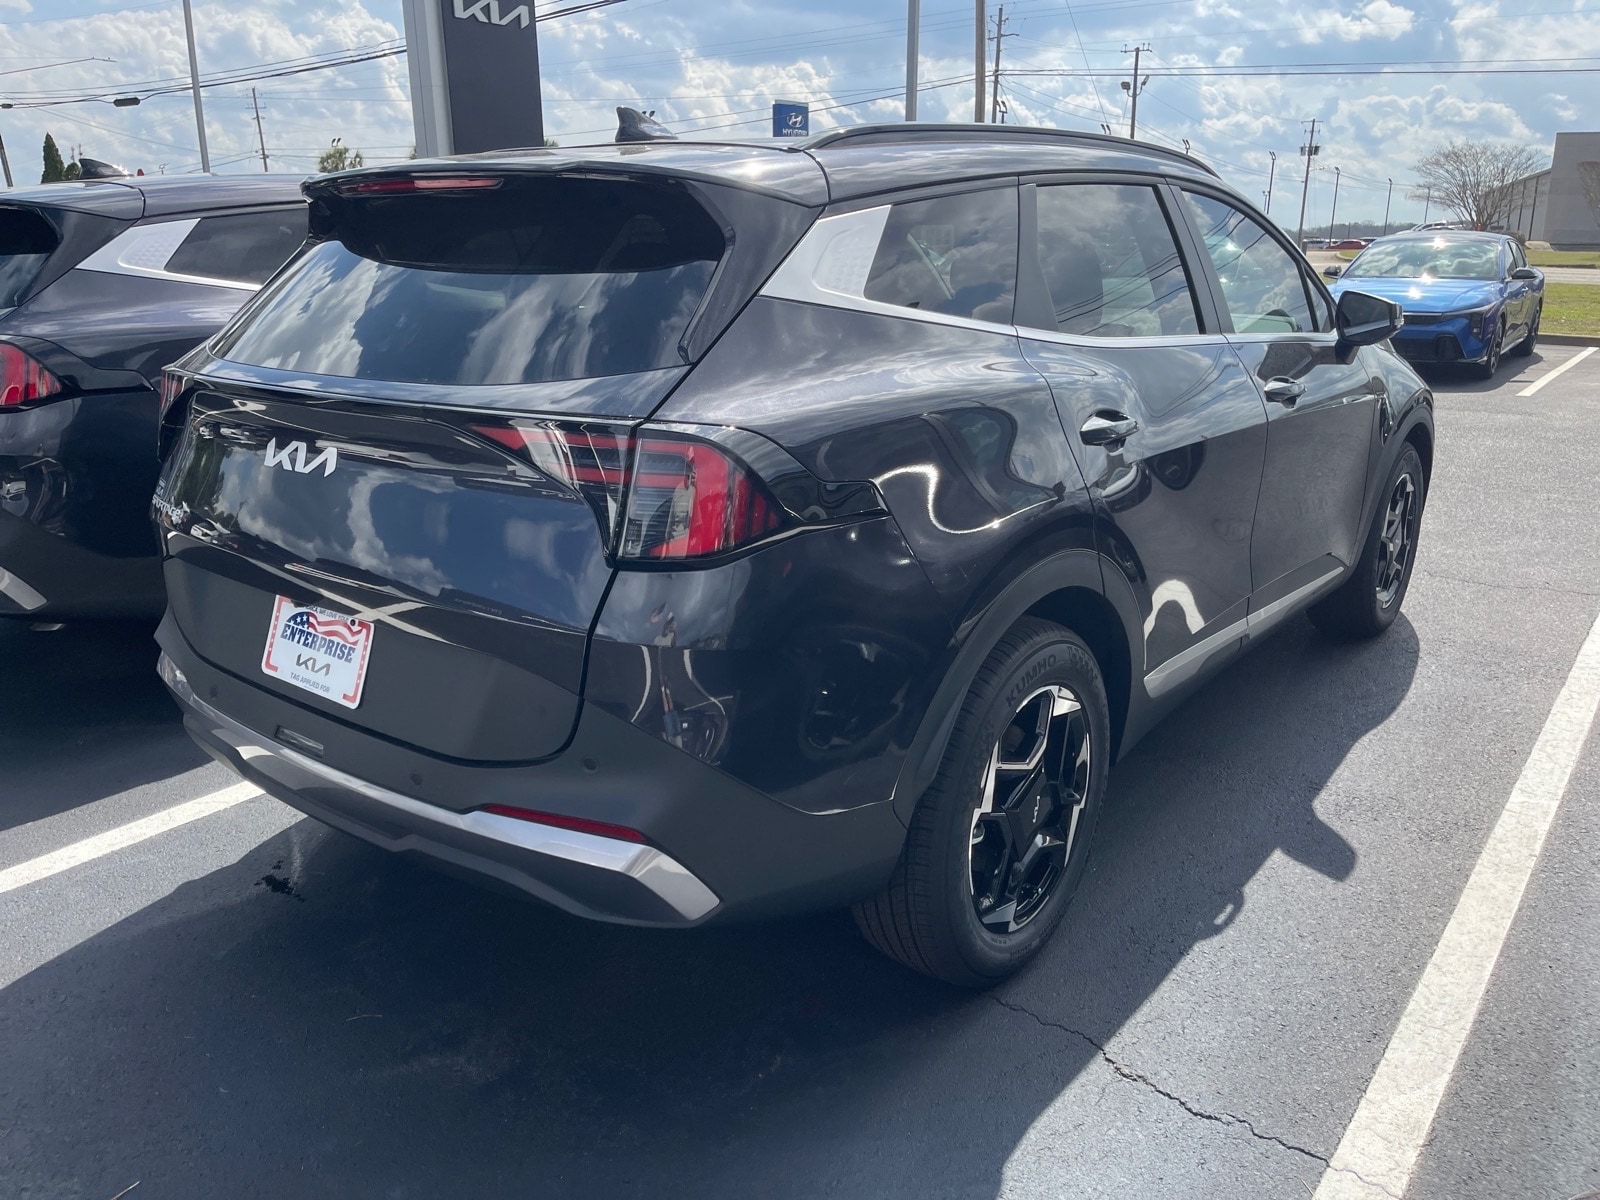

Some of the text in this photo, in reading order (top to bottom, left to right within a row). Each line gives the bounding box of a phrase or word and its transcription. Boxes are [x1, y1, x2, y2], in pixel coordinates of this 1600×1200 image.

[453, 0, 530, 29] KIA
[263, 437, 338, 478] KIA
[281, 622, 356, 664] ENTERPRISE
[290, 672, 301, 681] TAG
[300, 676, 320, 689] APPLIED
[320, 684, 330, 693] FOR
[296, 653, 331, 677] KIA
[1006, 654, 1057, 708] KUMHO
